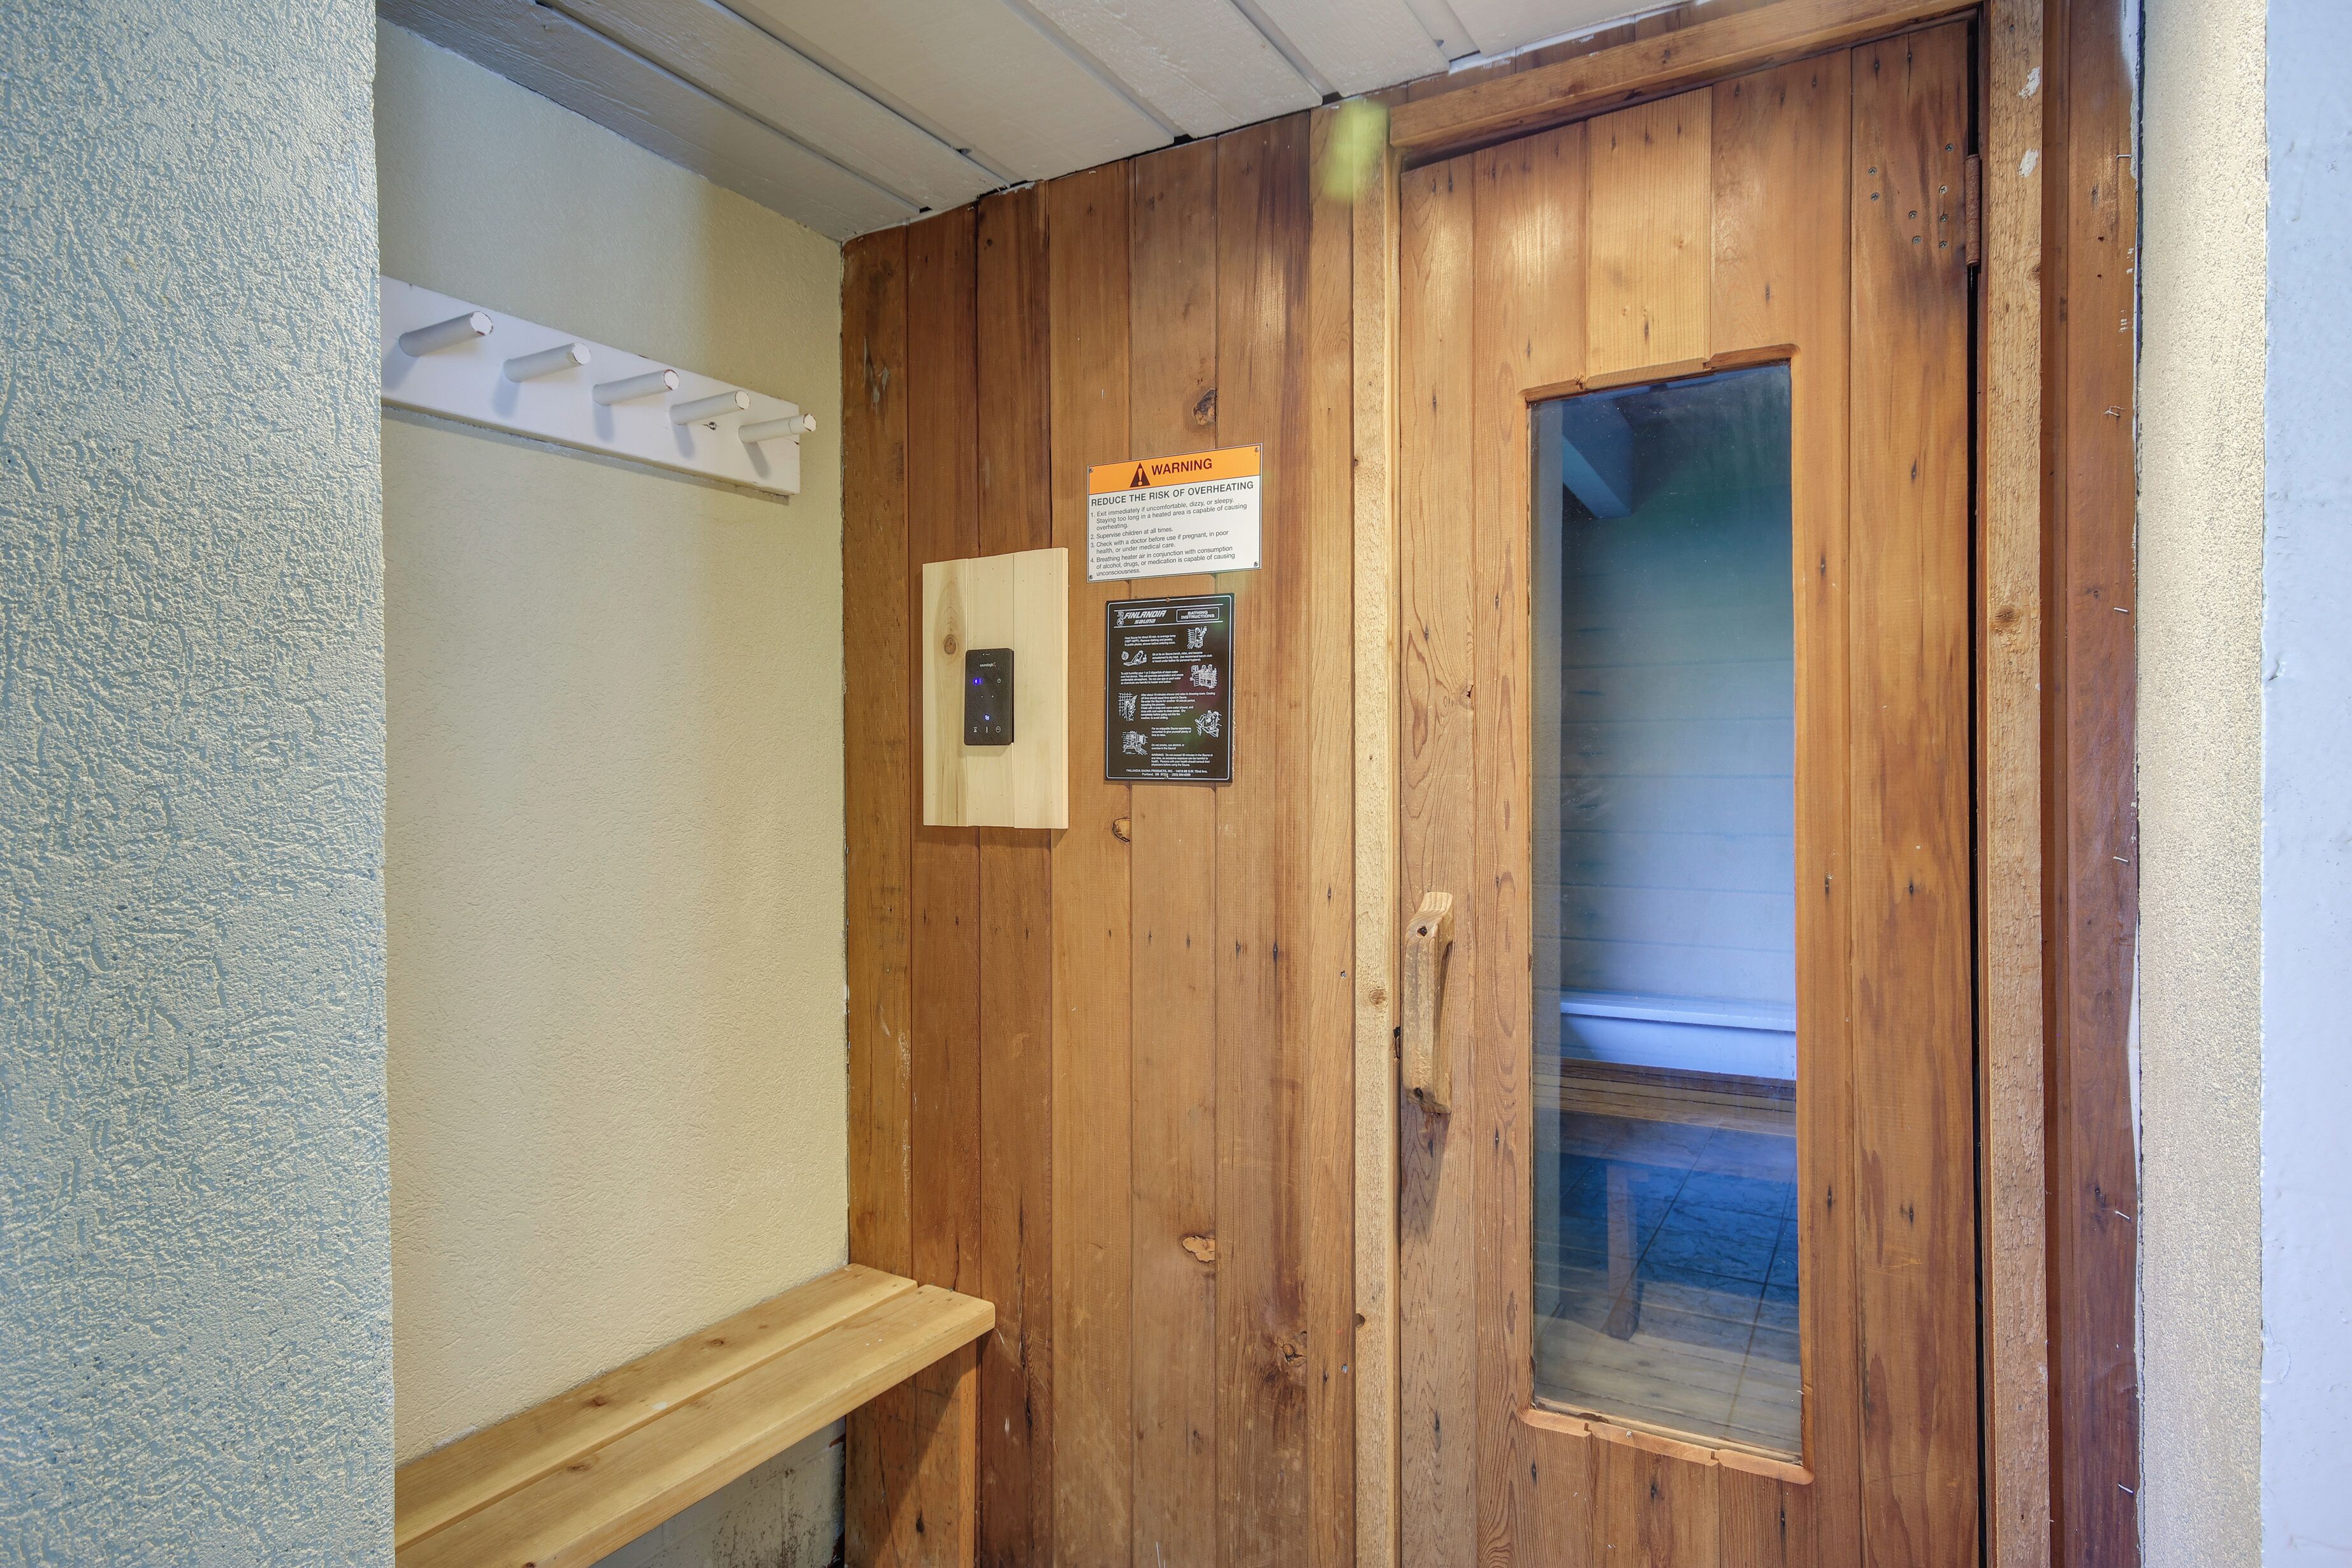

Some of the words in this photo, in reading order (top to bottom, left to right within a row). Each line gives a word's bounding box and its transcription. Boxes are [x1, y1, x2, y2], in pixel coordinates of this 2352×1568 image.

[1152, 458, 1212, 475] WARNING
[1091, 495, 1126, 506] REDUCE
[1129, 493, 1145, 502] THE
[1149, 491, 1169, 500] RISK
[1173, 489, 1184, 497] OF
[1188, 481, 1252, 495] OVERHEATING
[1147, 503, 1187, 511] uncomfortable,
[1124, 609, 1167, 620] FINLANDIA
